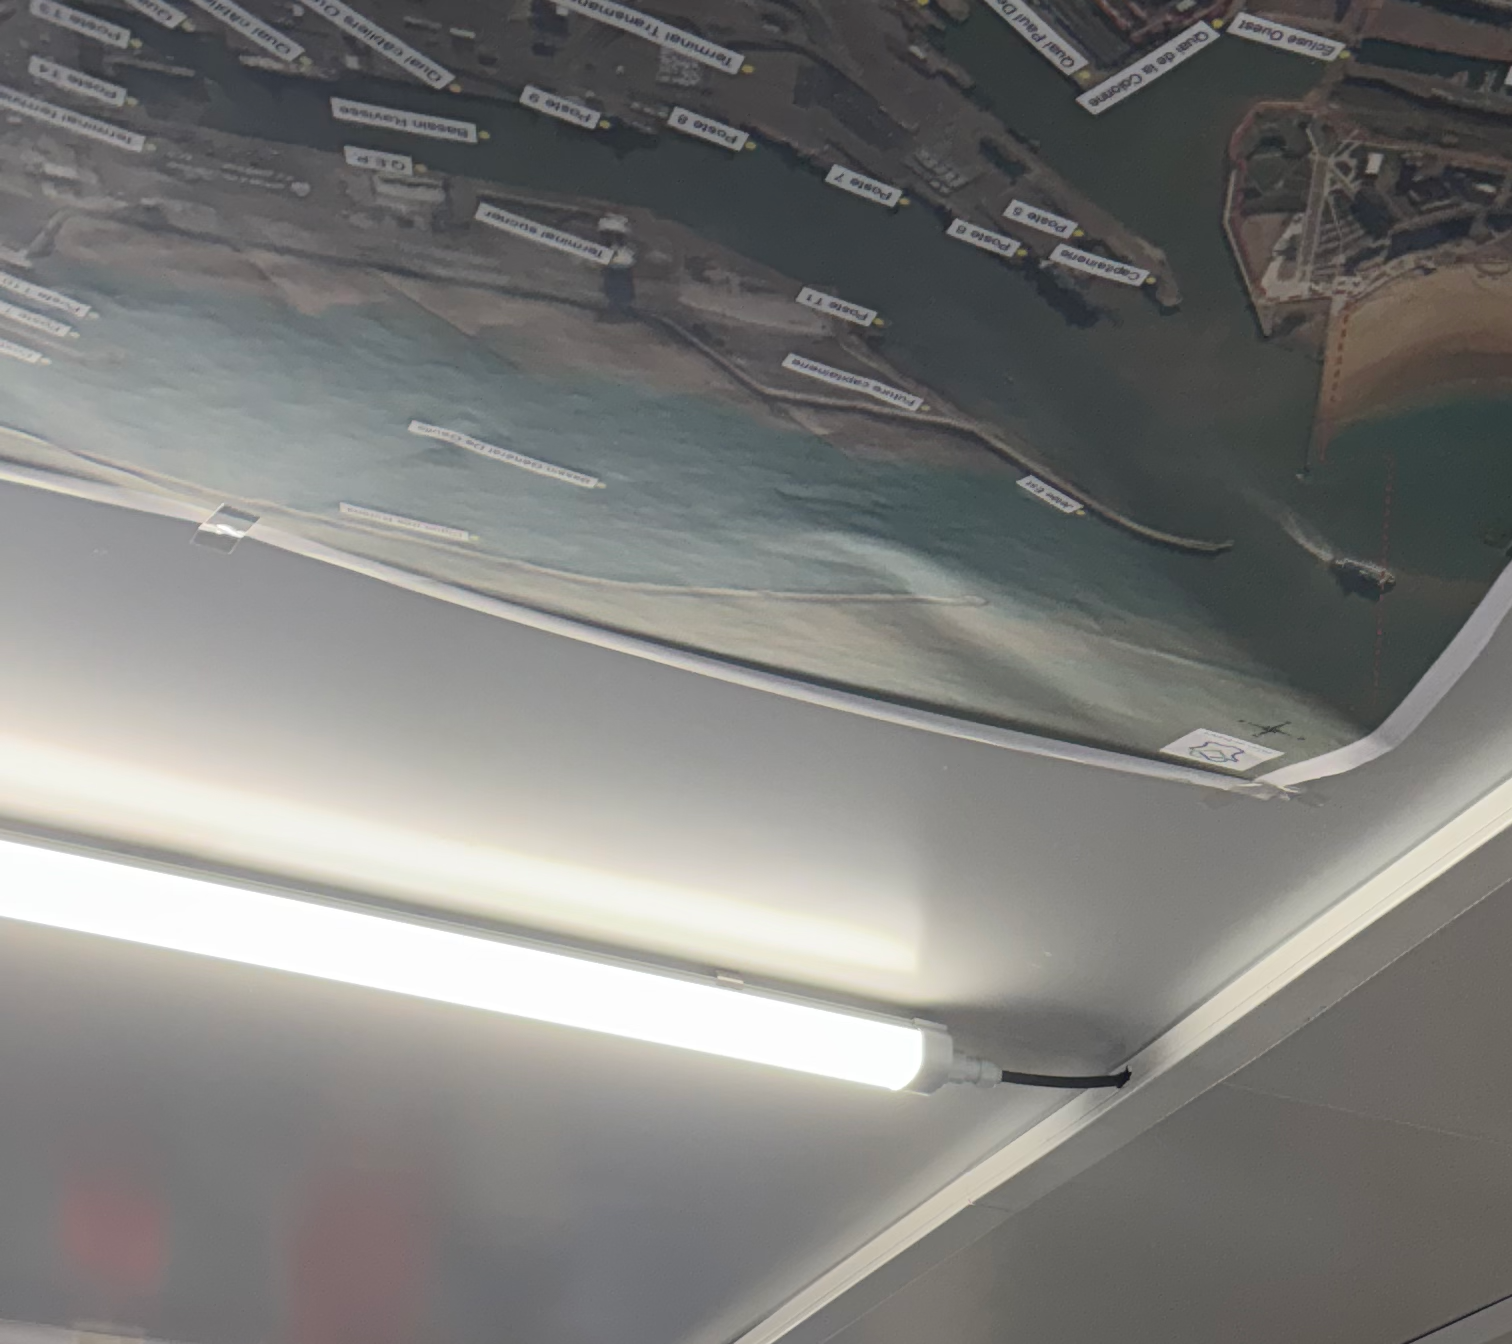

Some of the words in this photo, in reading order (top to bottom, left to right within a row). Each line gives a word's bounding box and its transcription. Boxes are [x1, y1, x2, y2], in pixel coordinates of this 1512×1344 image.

[70, 13, 121, 40] Poste
[1012, 13, 1046, 42] Paul
[1238, 19, 1284, 41] Ouest
[664, 29, 734, 67] Terminal
[1177, 31, 1209, 53] Quai
[1042, 42, 1075, 68] Quai
[1156, 50, 1176, 66] de
[404, 55, 441, 81] Quai
[67, 74, 117, 99] Poste
[1089, 73, 1142, 107] Colonne
[545, 99, 592, 123] Poste
[62, 112, 131, 143] Terminal
[413, 120, 468, 138] Bassin
[693, 120, 738, 144] Poste
[835, 173, 845, 183] 7
[849, 178, 893, 200] Poste
[1027, 211, 1068, 233] Poste
[540, 230, 604, 259] Terminal
[970, 230, 1011, 252] Poste
[828, 301, 868, 322] Poste
